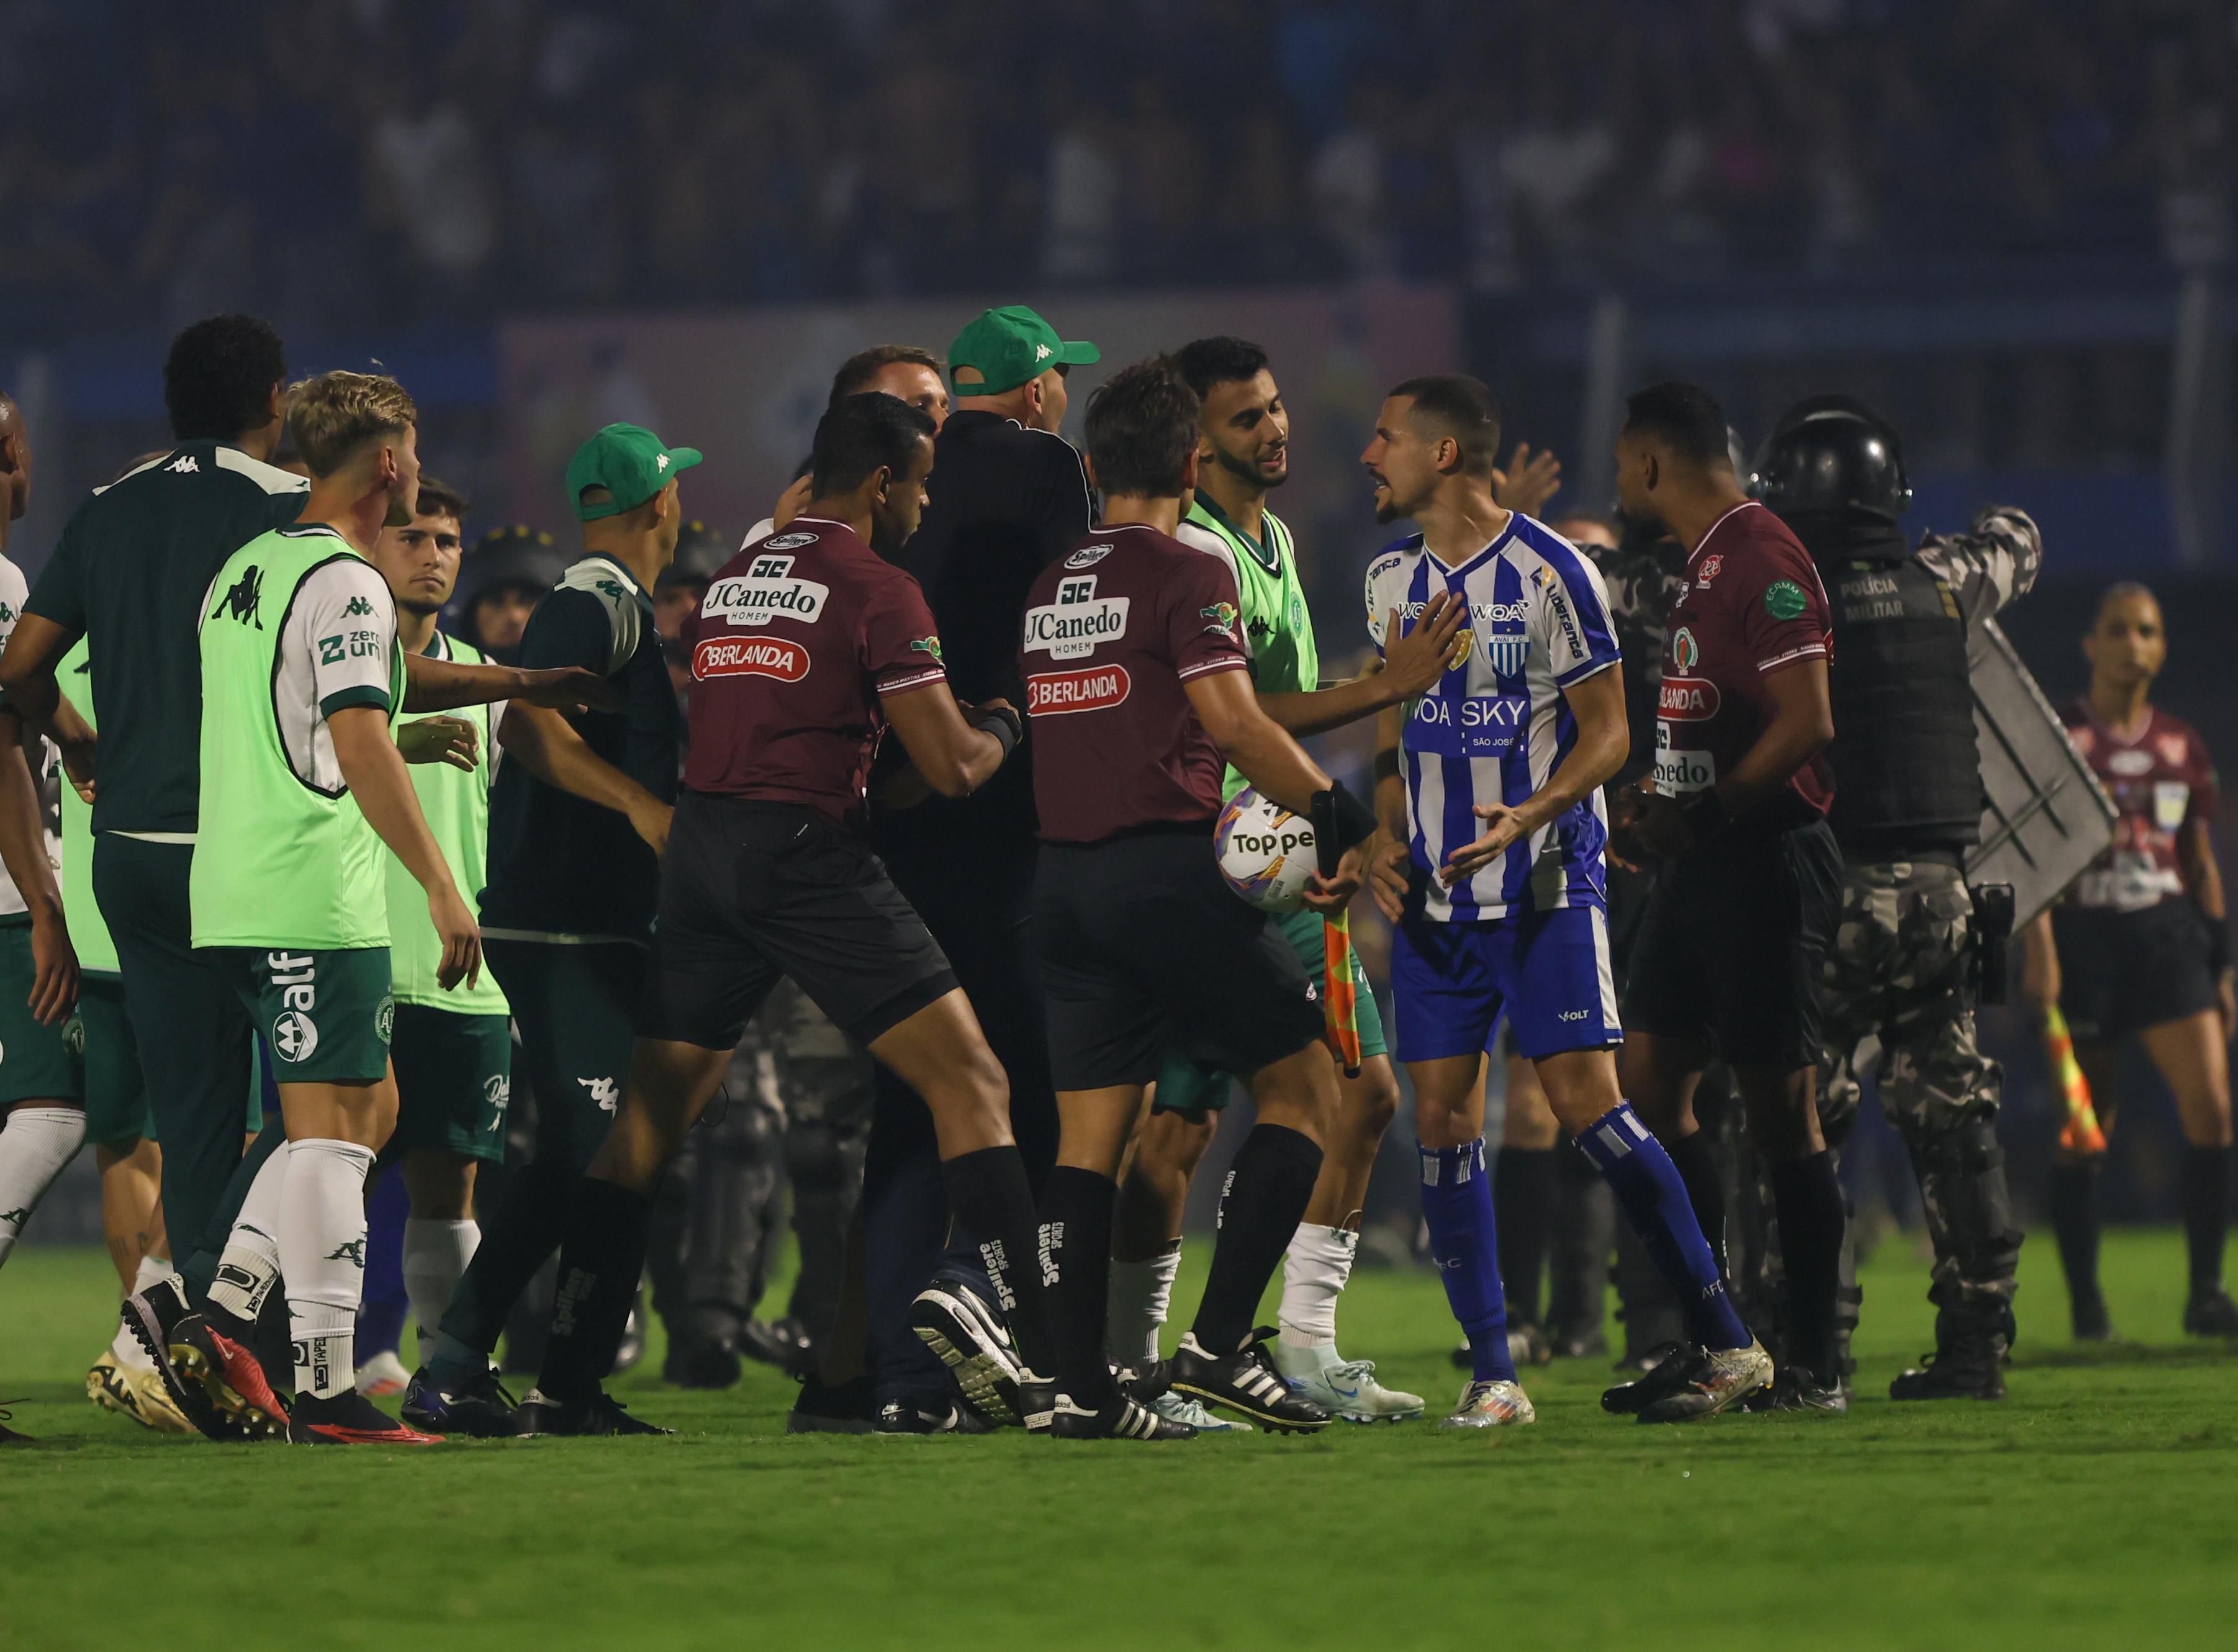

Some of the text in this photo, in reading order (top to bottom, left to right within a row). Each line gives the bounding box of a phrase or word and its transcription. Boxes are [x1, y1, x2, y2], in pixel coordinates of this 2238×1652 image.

[706, 584, 816, 613] JCanedo
[1397, 602, 1427, 620] WO
[731, 612, 769, 621] HOMEM
[1026, 605, 1121, 643] JCanedo
[1471, 603, 1527, 621] WOA
[1055, 642, 1091, 654] HOMEM
[1461, 700, 1527, 726] SKY
[1473, 737, 1491, 746] SÃO
[1653, 757, 1708, 783] nedo
[1232, 831, 1314, 856] Toppe
[1558, 1009, 1589, 1022] VOLT
[1051, 1221, 1064, 1249] SPORTS
[991, 1239, 1009, 1270] SPORTS
[1038, 1223, 1060, 1288] Spillere
[980, 1244, 1017, 1312] Spillere
